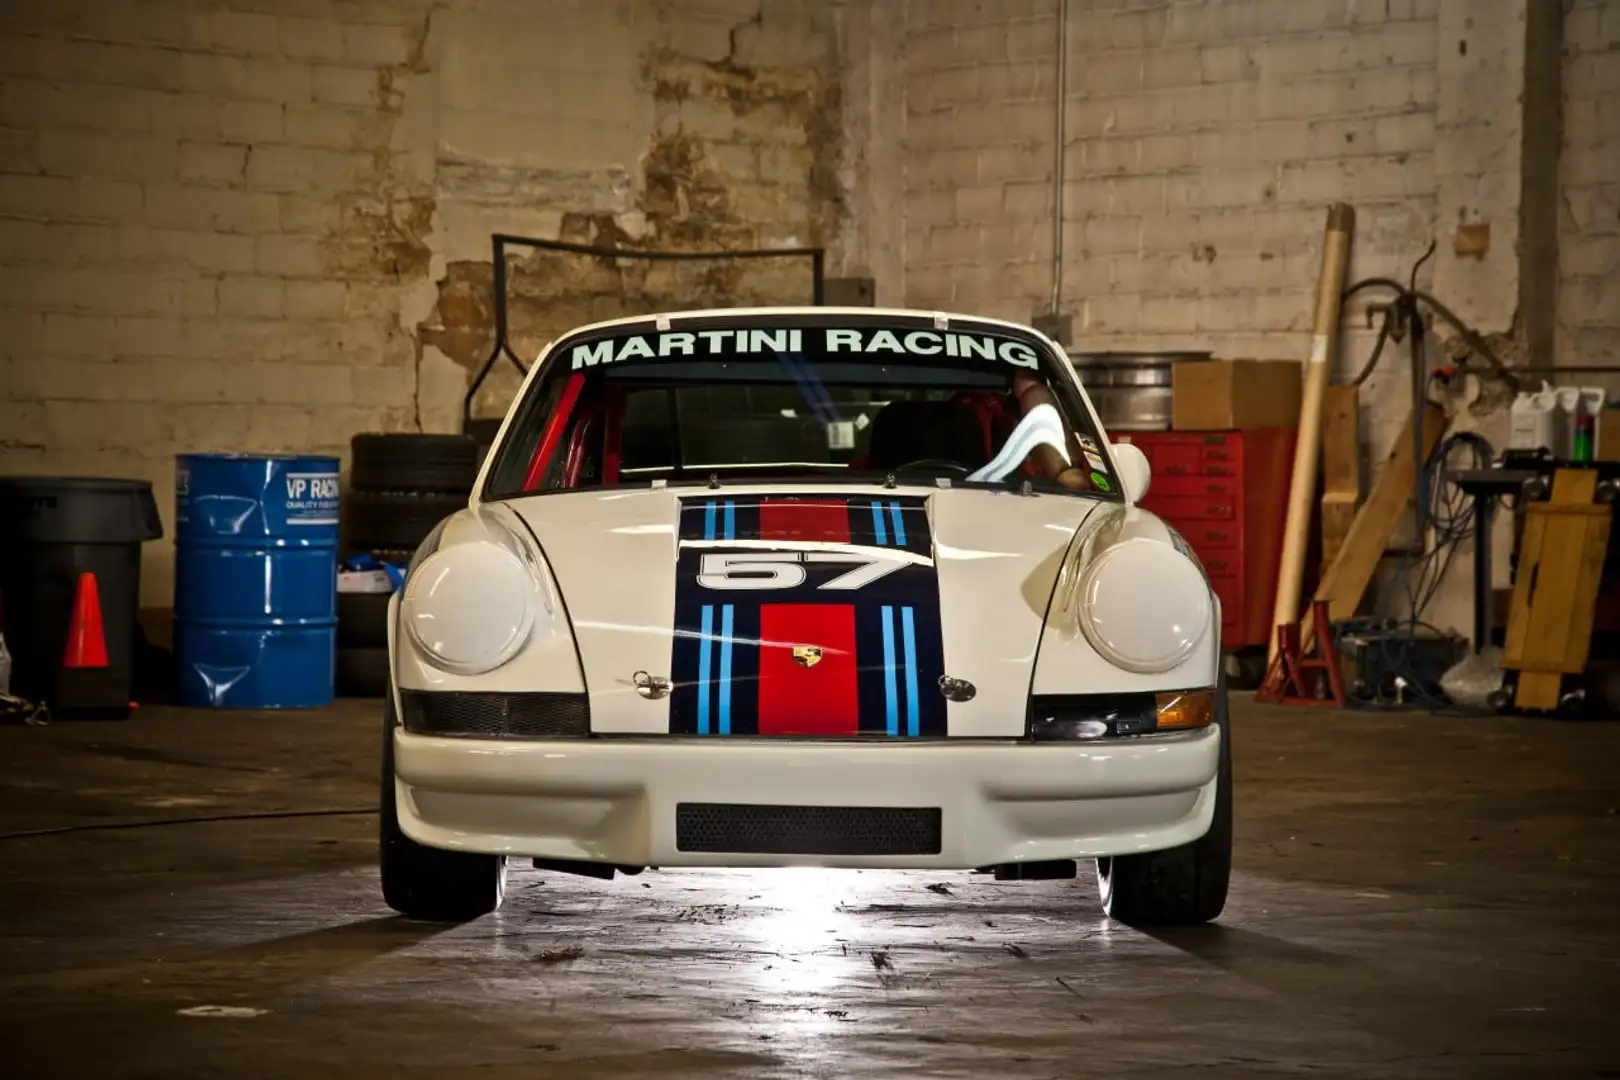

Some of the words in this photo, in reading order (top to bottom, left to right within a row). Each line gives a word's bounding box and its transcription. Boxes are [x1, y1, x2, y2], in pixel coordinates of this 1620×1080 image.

[572, 329, 802, 370] MARTINI
[825, 329, 1039, 370] RACING
[286, 479, 307, 499] VP
[696, 552, 913, 590] 57
